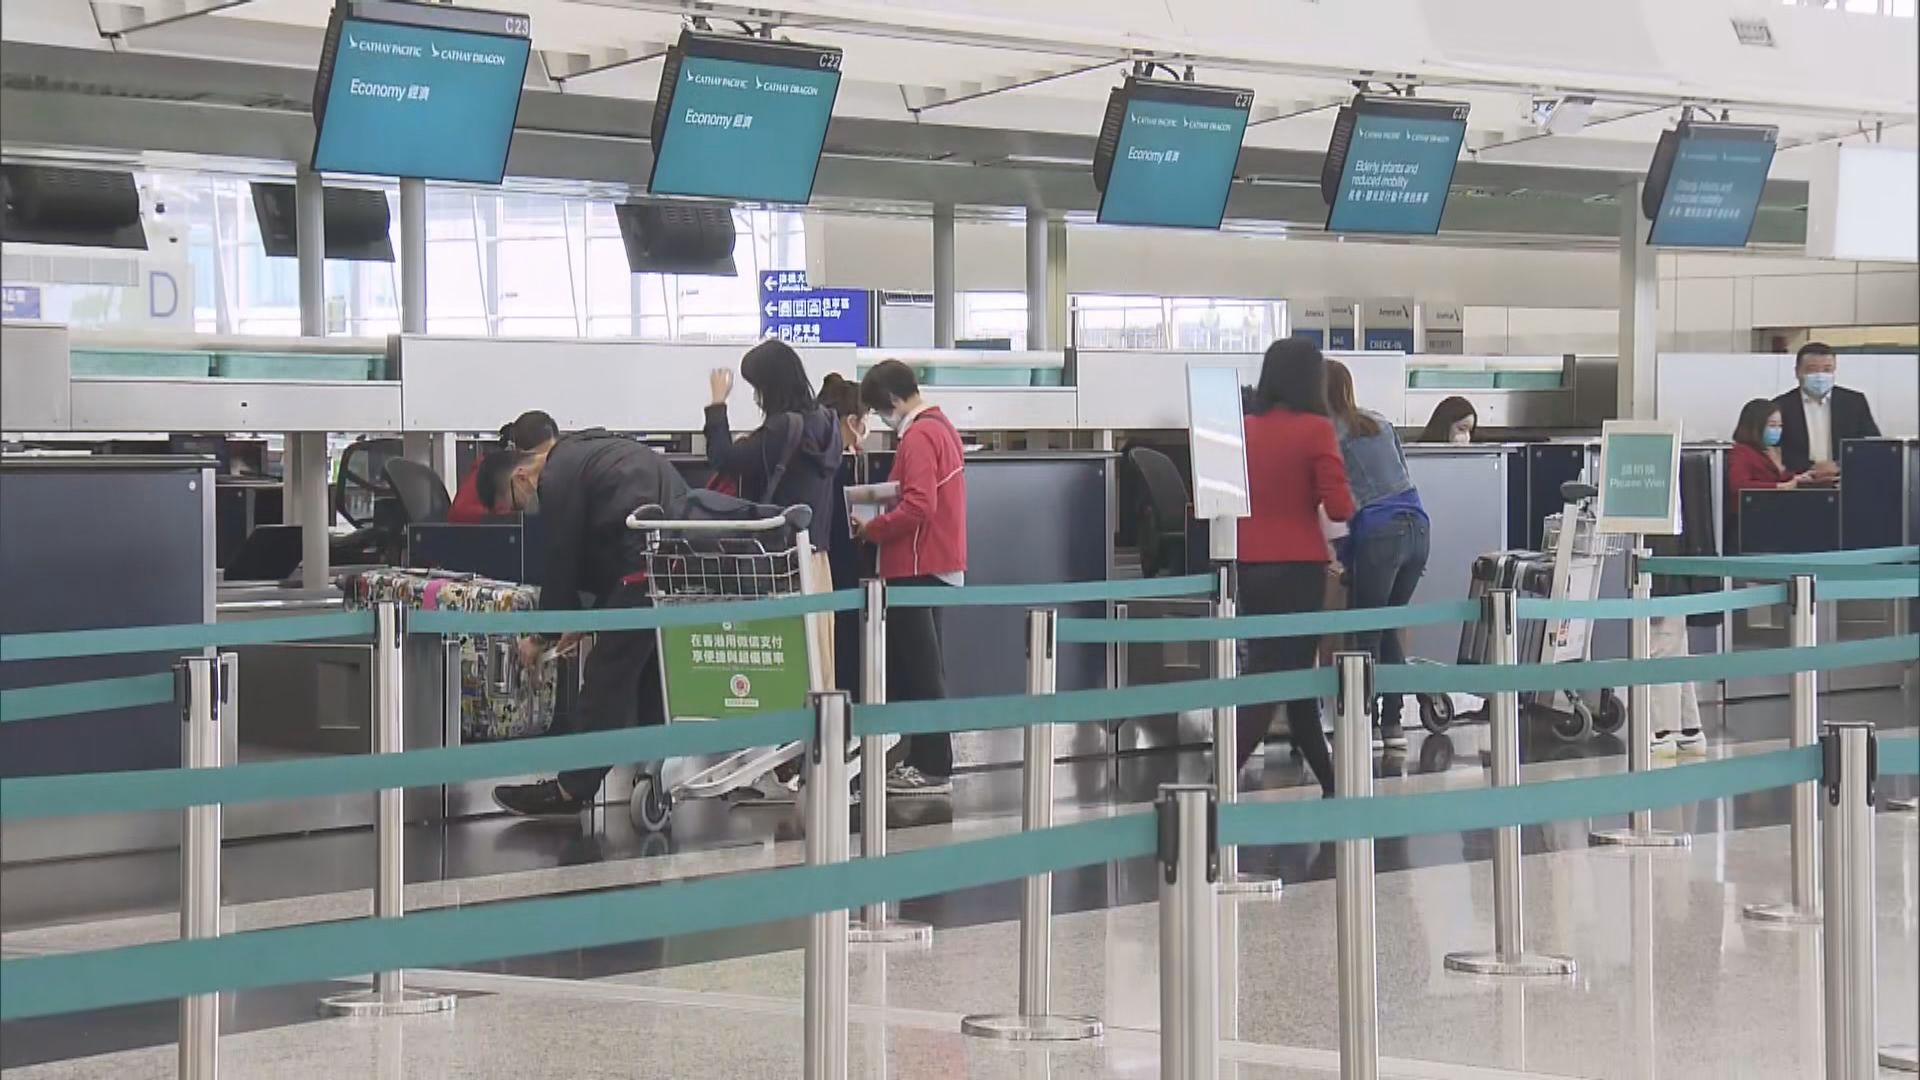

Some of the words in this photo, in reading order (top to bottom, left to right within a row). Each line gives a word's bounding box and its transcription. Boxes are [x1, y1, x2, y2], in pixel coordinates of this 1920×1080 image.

[505, 17, 529, 35] C23
[359, 40, 391, 54] CATHAY
[392, 45, 422, 57] PACIFIC
[441, 50, 473, 62] CATHAY
[473, 53, 505, 65] DRAGON
[819, 54, 841, 68] C22
[695, 74, 722, 86] CATHAY
[722, 77, 749, 89] PACIFIC
[764, 81, 790, 93] CATHAY
[790, 84, 818, 96] DRAGON
[350, 78, 406, 101] Economy
[407, 85, 430, 100] 經濟
[1235, 94, 1253, 108] C21
[685, 108, 732, 130] Economy
[1128, 146, 1164, 164] Economy
[1405, 162, 1419, 175] and
[1352, 175, 1381, 186] reduced
[1381, 176, 1408, 190] mobility
[149, 270, 178, 317] D
[1369, 340, 1402, 350] CHECK-IN
[691, 634, 782, 649] 在香港用微信支付
